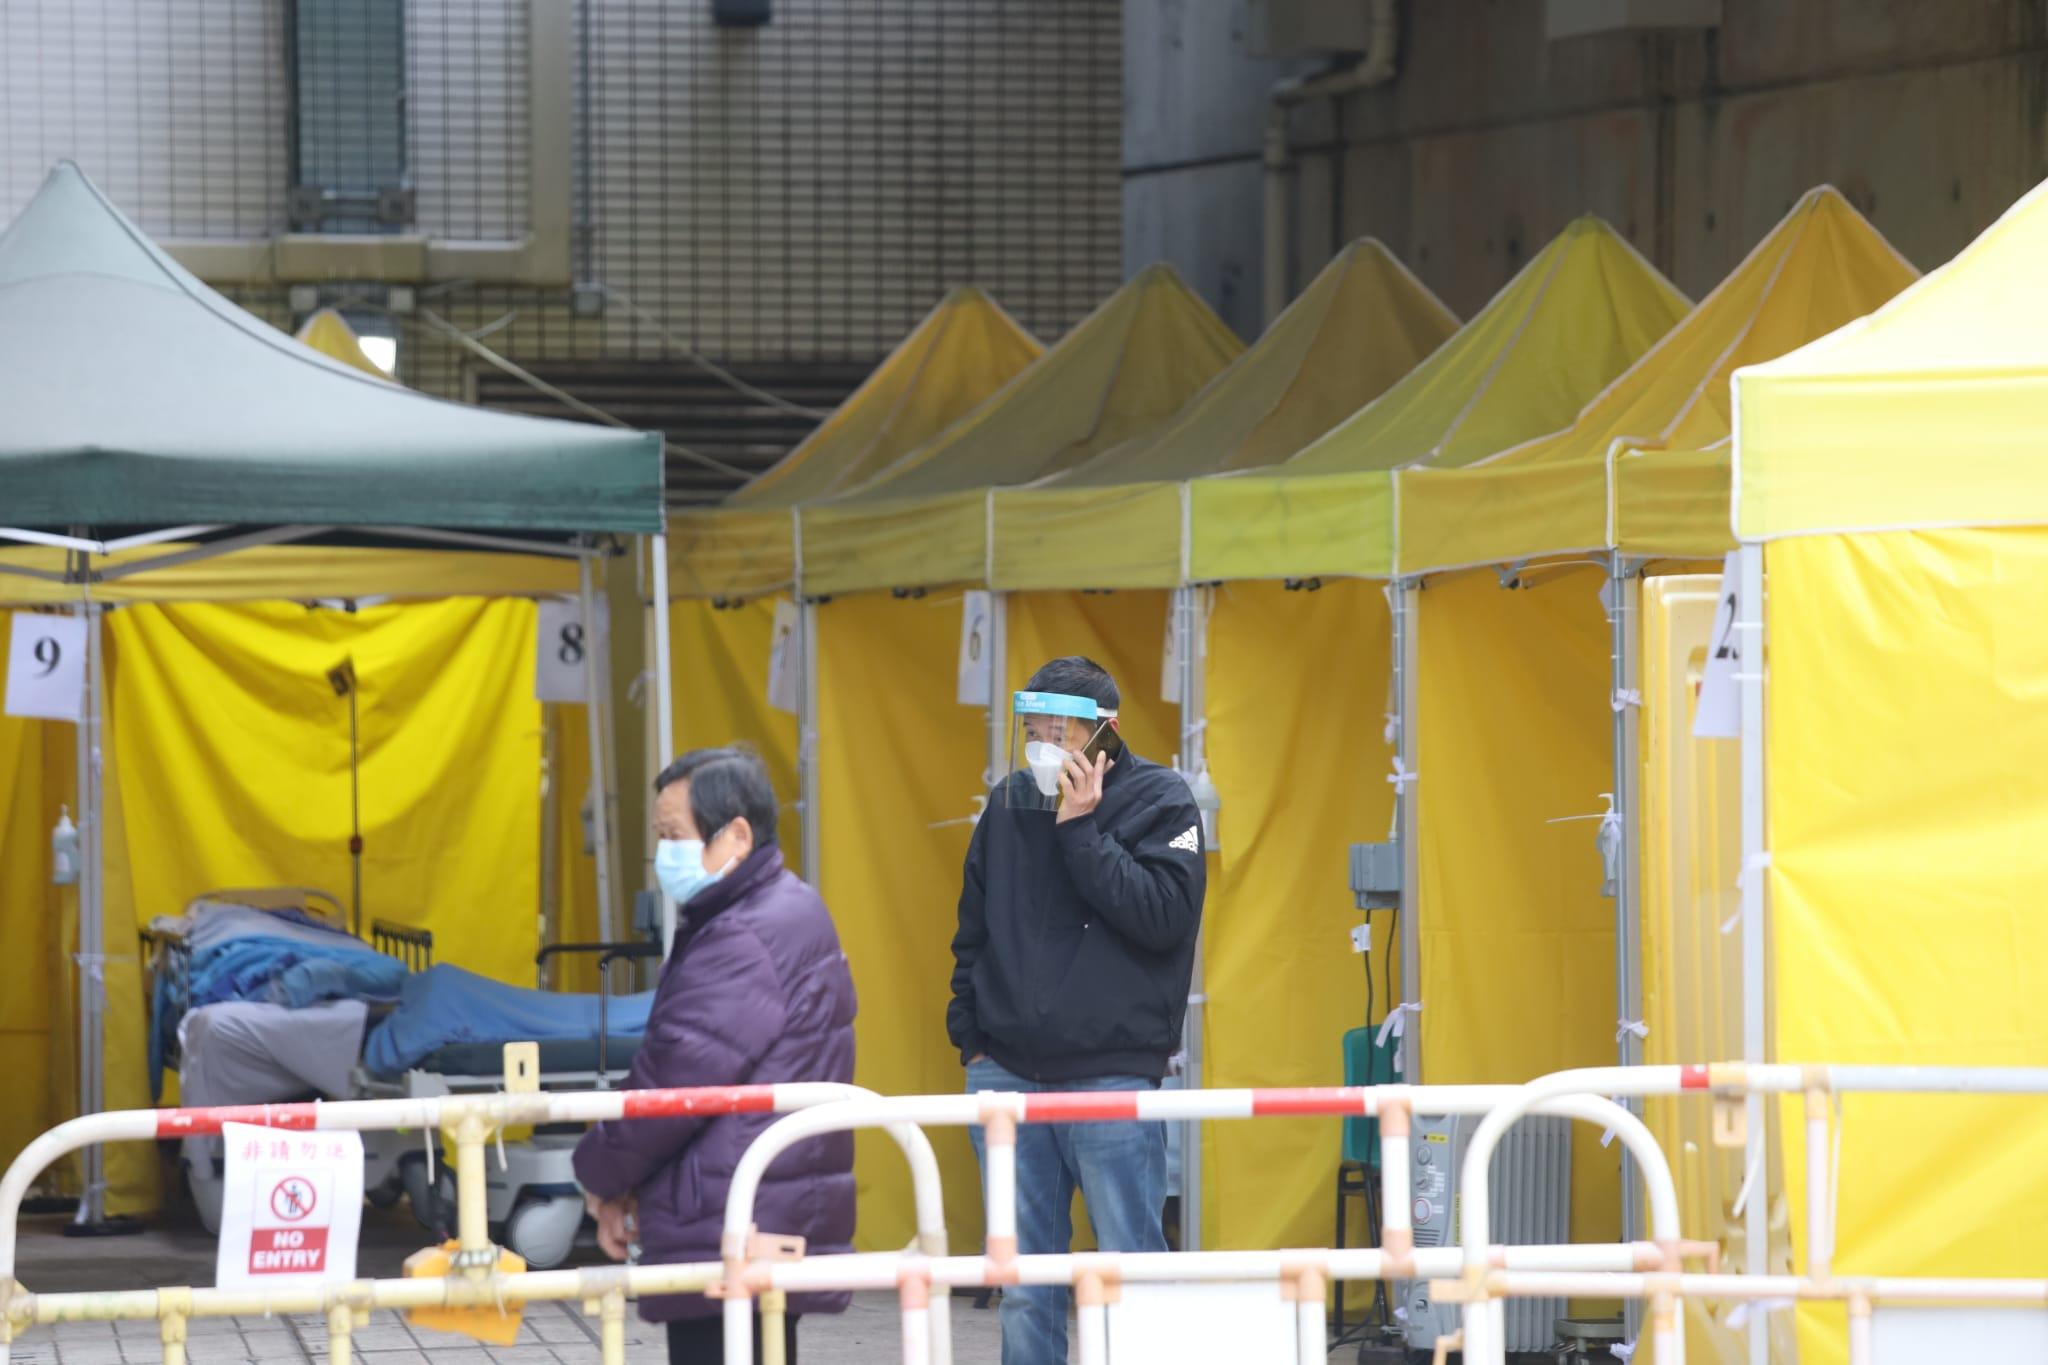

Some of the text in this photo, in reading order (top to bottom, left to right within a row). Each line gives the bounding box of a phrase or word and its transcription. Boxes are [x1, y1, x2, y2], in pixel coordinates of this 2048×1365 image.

[33, 636, 62, 679] 9
[557, 622, 585, 667] 8
[968, 613, 984, 662] 6
[252, 1249, 321, 1268] ENTRY
[272, 1230, 304, 1248] NO
